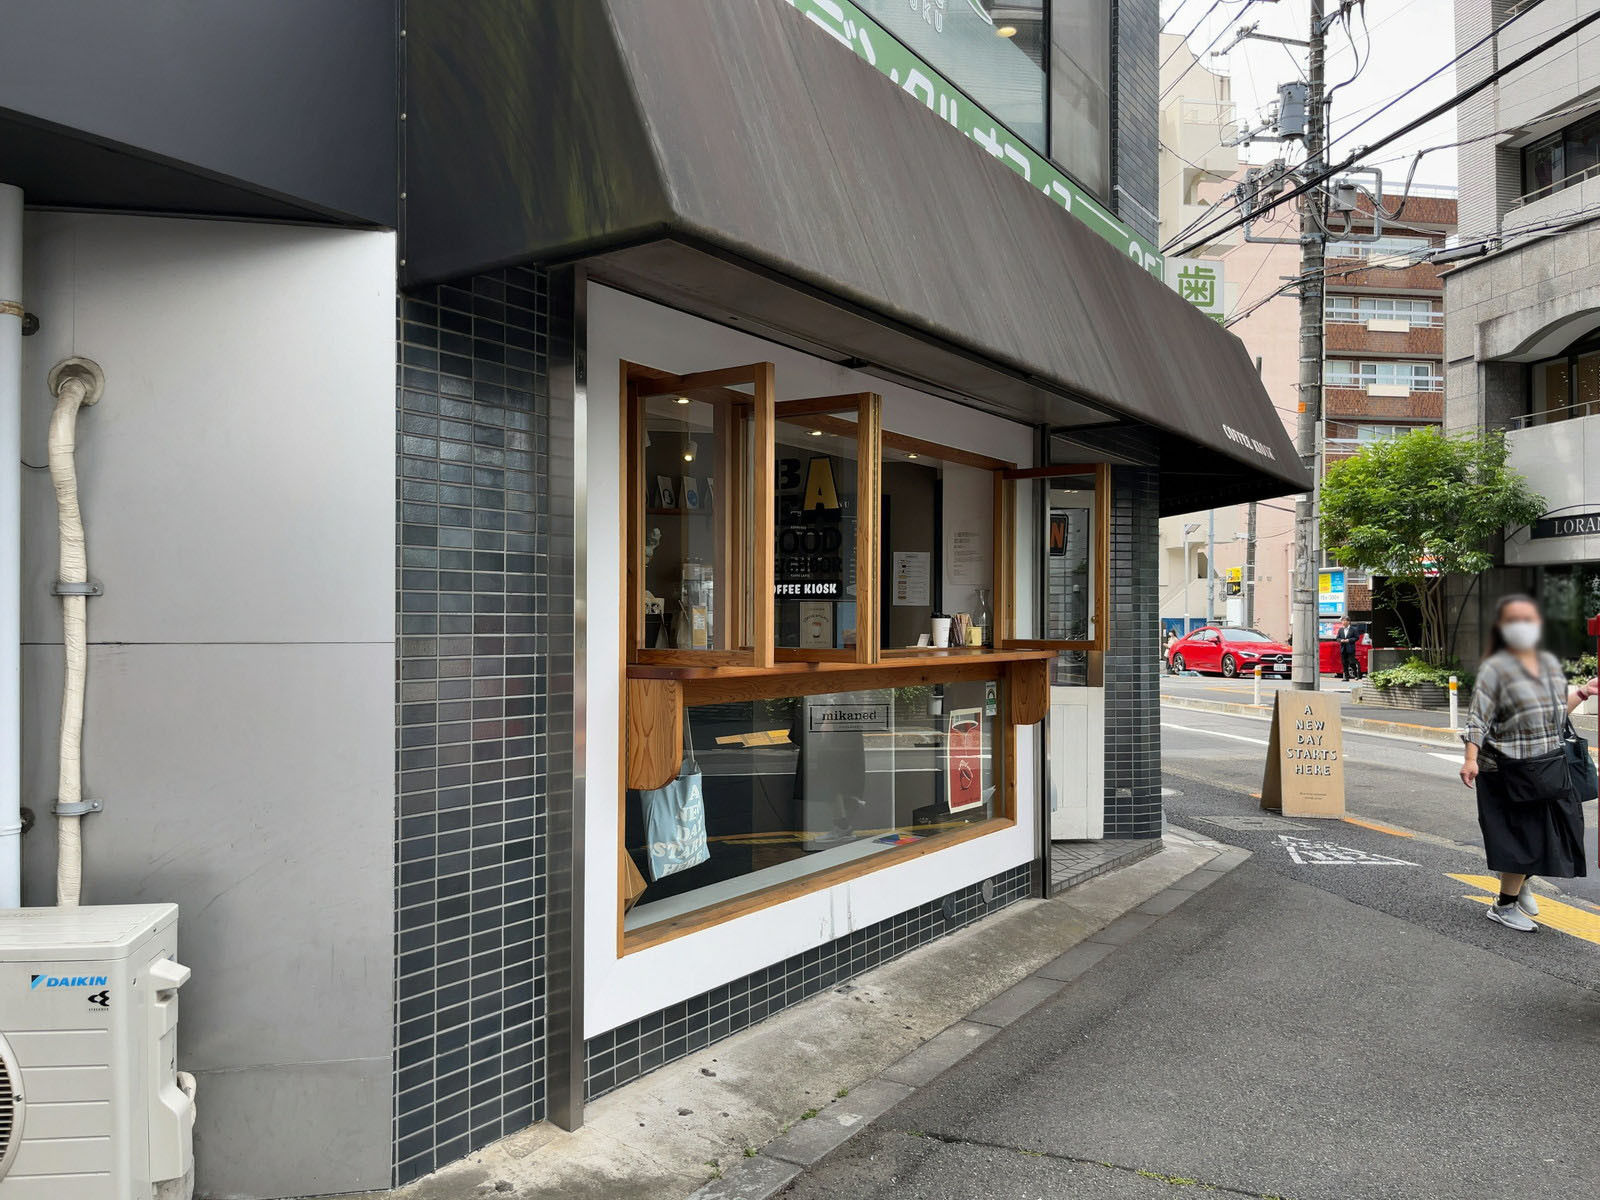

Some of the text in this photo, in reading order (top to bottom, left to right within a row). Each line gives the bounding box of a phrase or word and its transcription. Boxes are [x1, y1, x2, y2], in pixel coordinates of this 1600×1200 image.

[1177, 265, 1216, 308] 歯
[774, 527, 842, 554] OOD
[804, 583, 837, 594] KIOSK
[822, 710, 877, 721] mikaned
[1304, 704, 1313, 716] A
[1295, 719, 1325, 731] NEW
[1297, 734, 1323, 746] DAY
[1286, 748, 1338, 761] STARTS
[1296, 764, 1332, 776] HERE
[689, 784, 700, 801] A
[46, 975, 108, 988] DAIKIN
